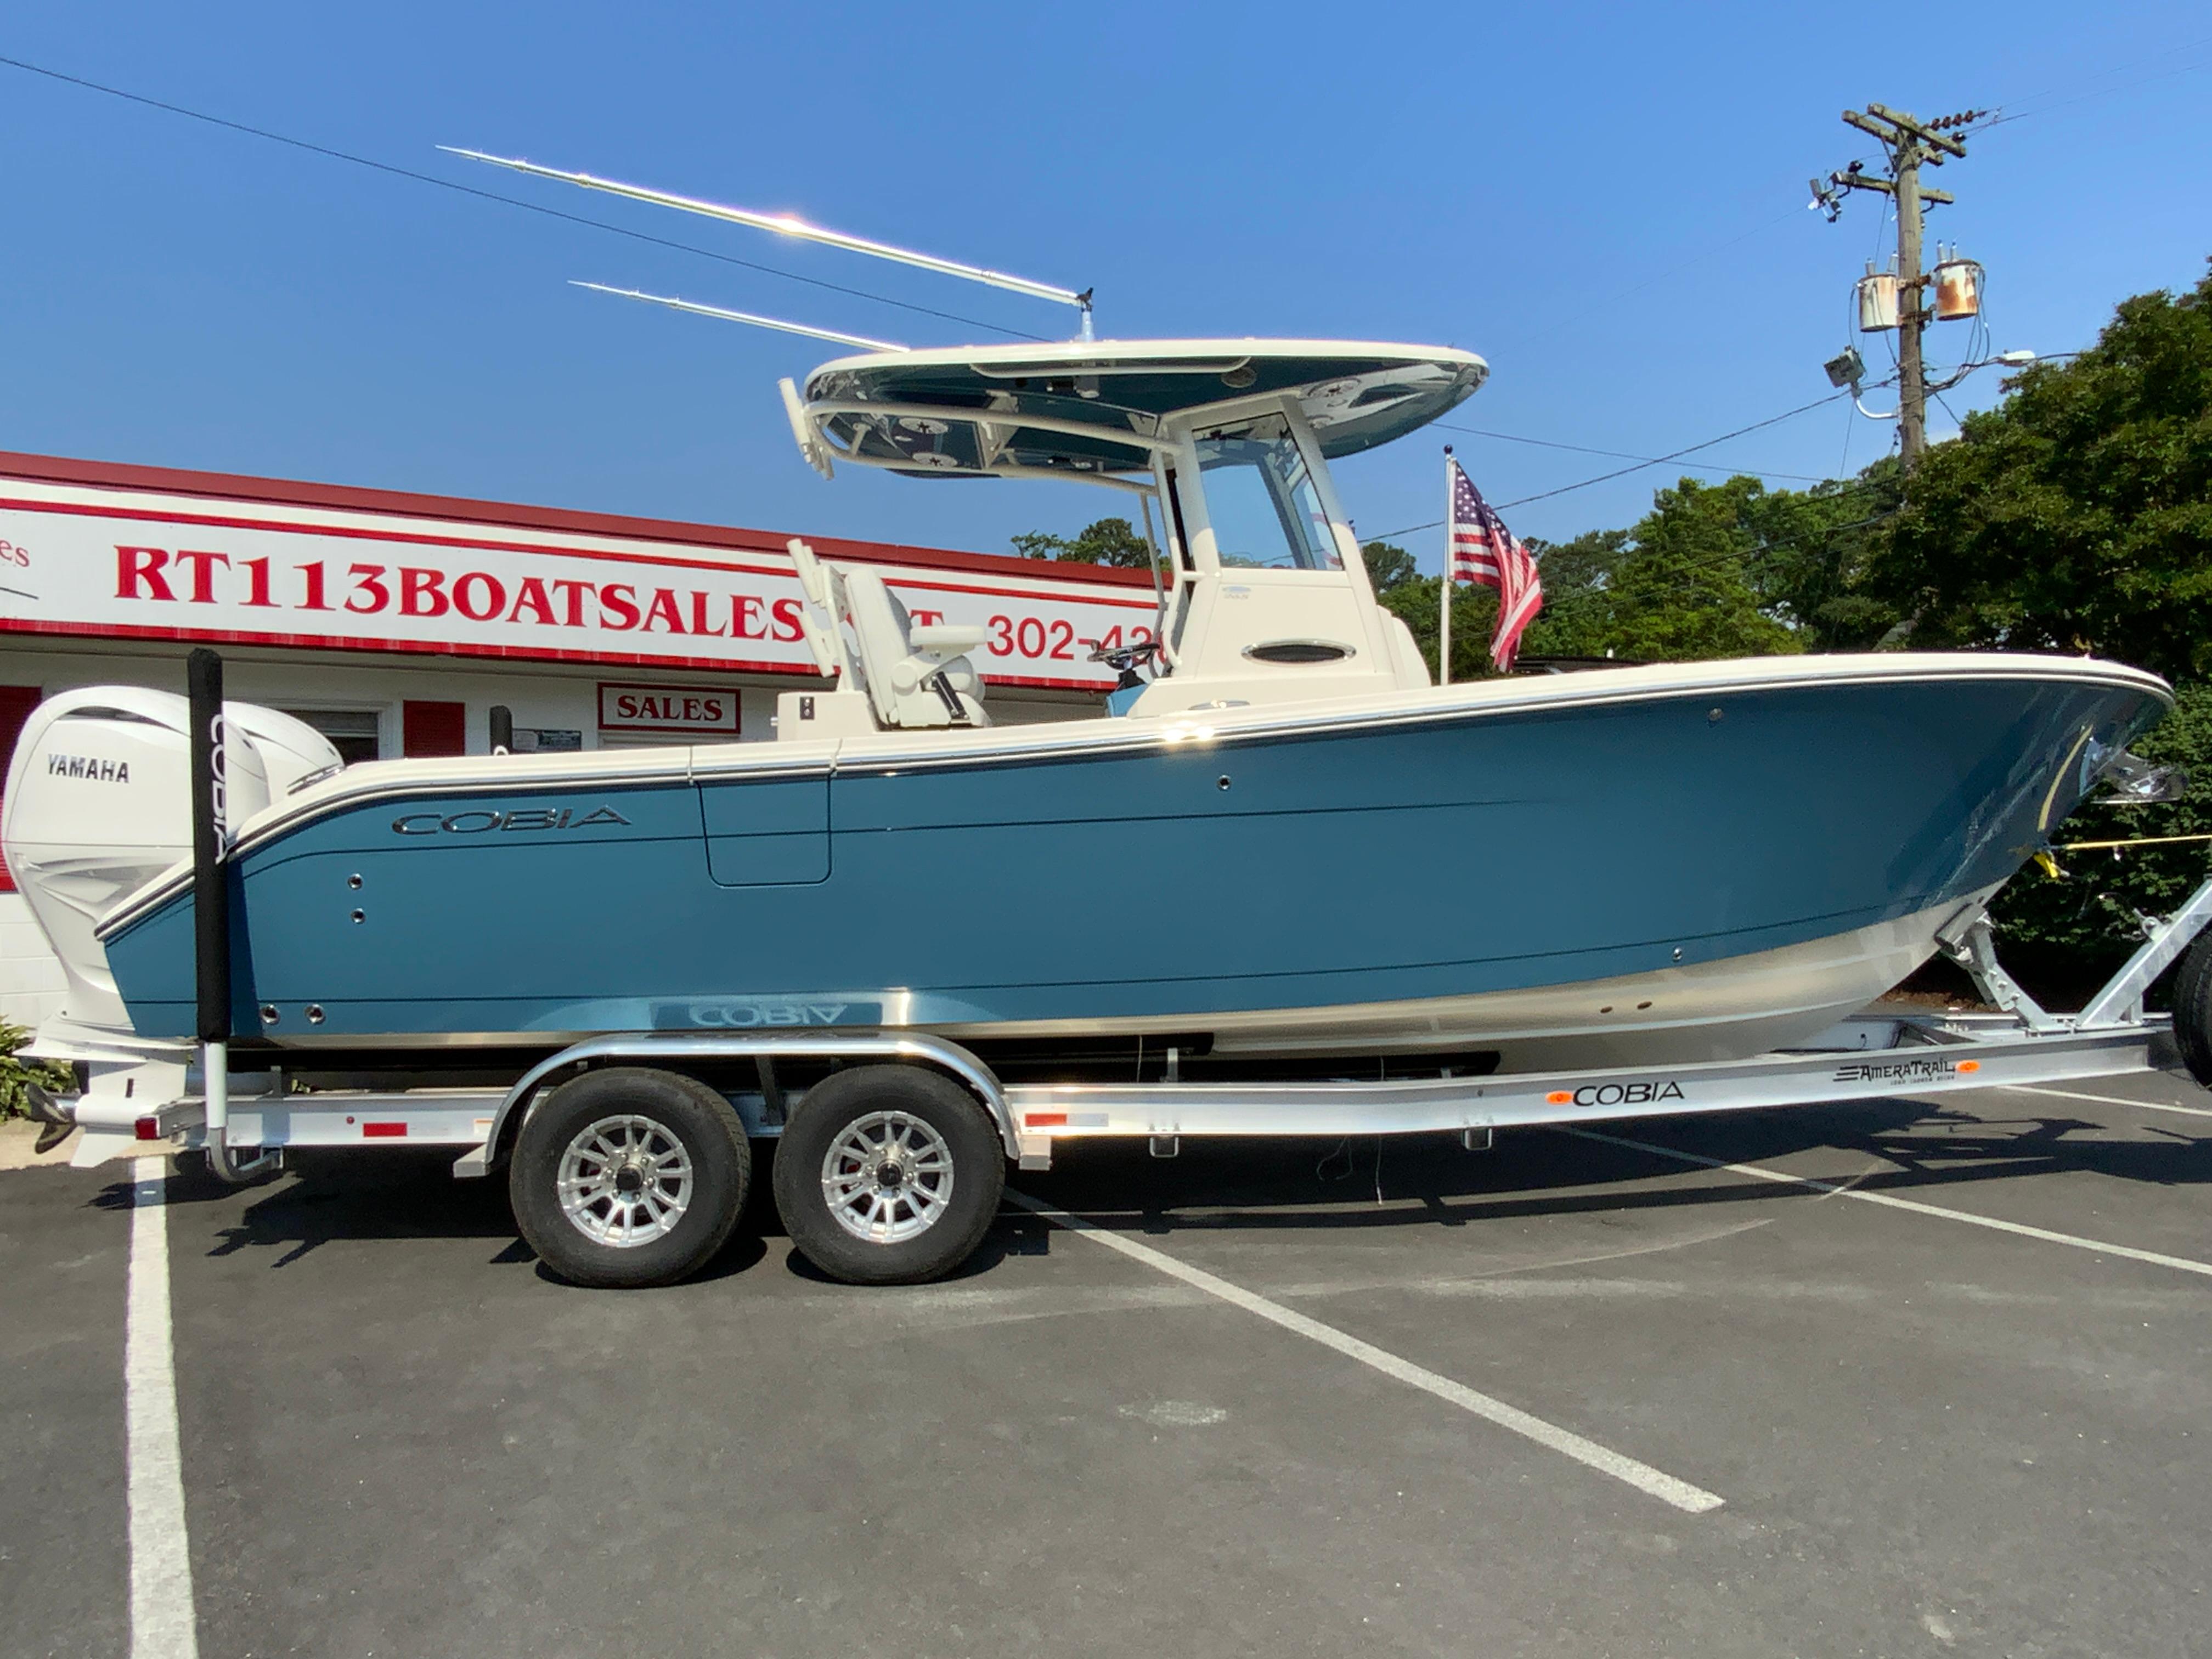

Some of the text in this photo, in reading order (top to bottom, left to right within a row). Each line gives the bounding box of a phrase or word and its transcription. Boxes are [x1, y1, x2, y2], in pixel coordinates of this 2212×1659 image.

[114, 545, 805, 642] RT113BOATSALES
[617, 695, 723, 721] SALES
[48, 754, 129, 783] YAMAHA
[392, 804, 632, 835] COBIA
[1572, 1081, 1685, 1107] COBIA
